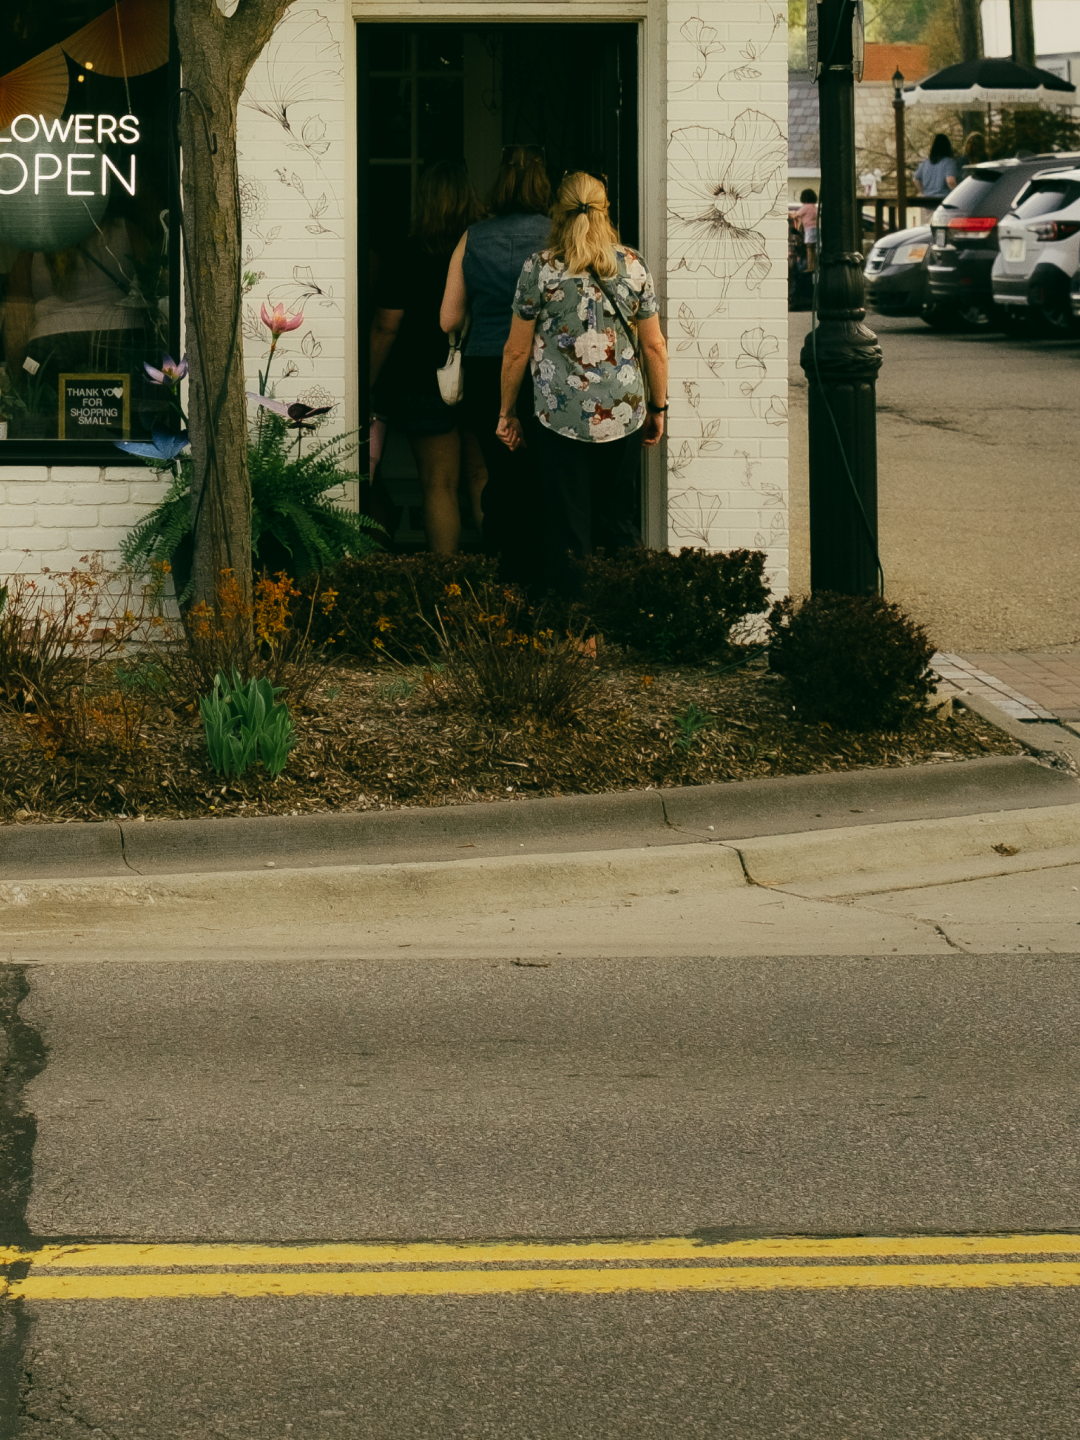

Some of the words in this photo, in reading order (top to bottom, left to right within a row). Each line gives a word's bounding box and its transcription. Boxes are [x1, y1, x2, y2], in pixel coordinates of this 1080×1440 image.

[67, 387, 100, 397] THANK
[82, 398, 103, 407] FOR
[70, 407, 118, 418] SHOPPING
[77, 416, 112, 426] SMALL
